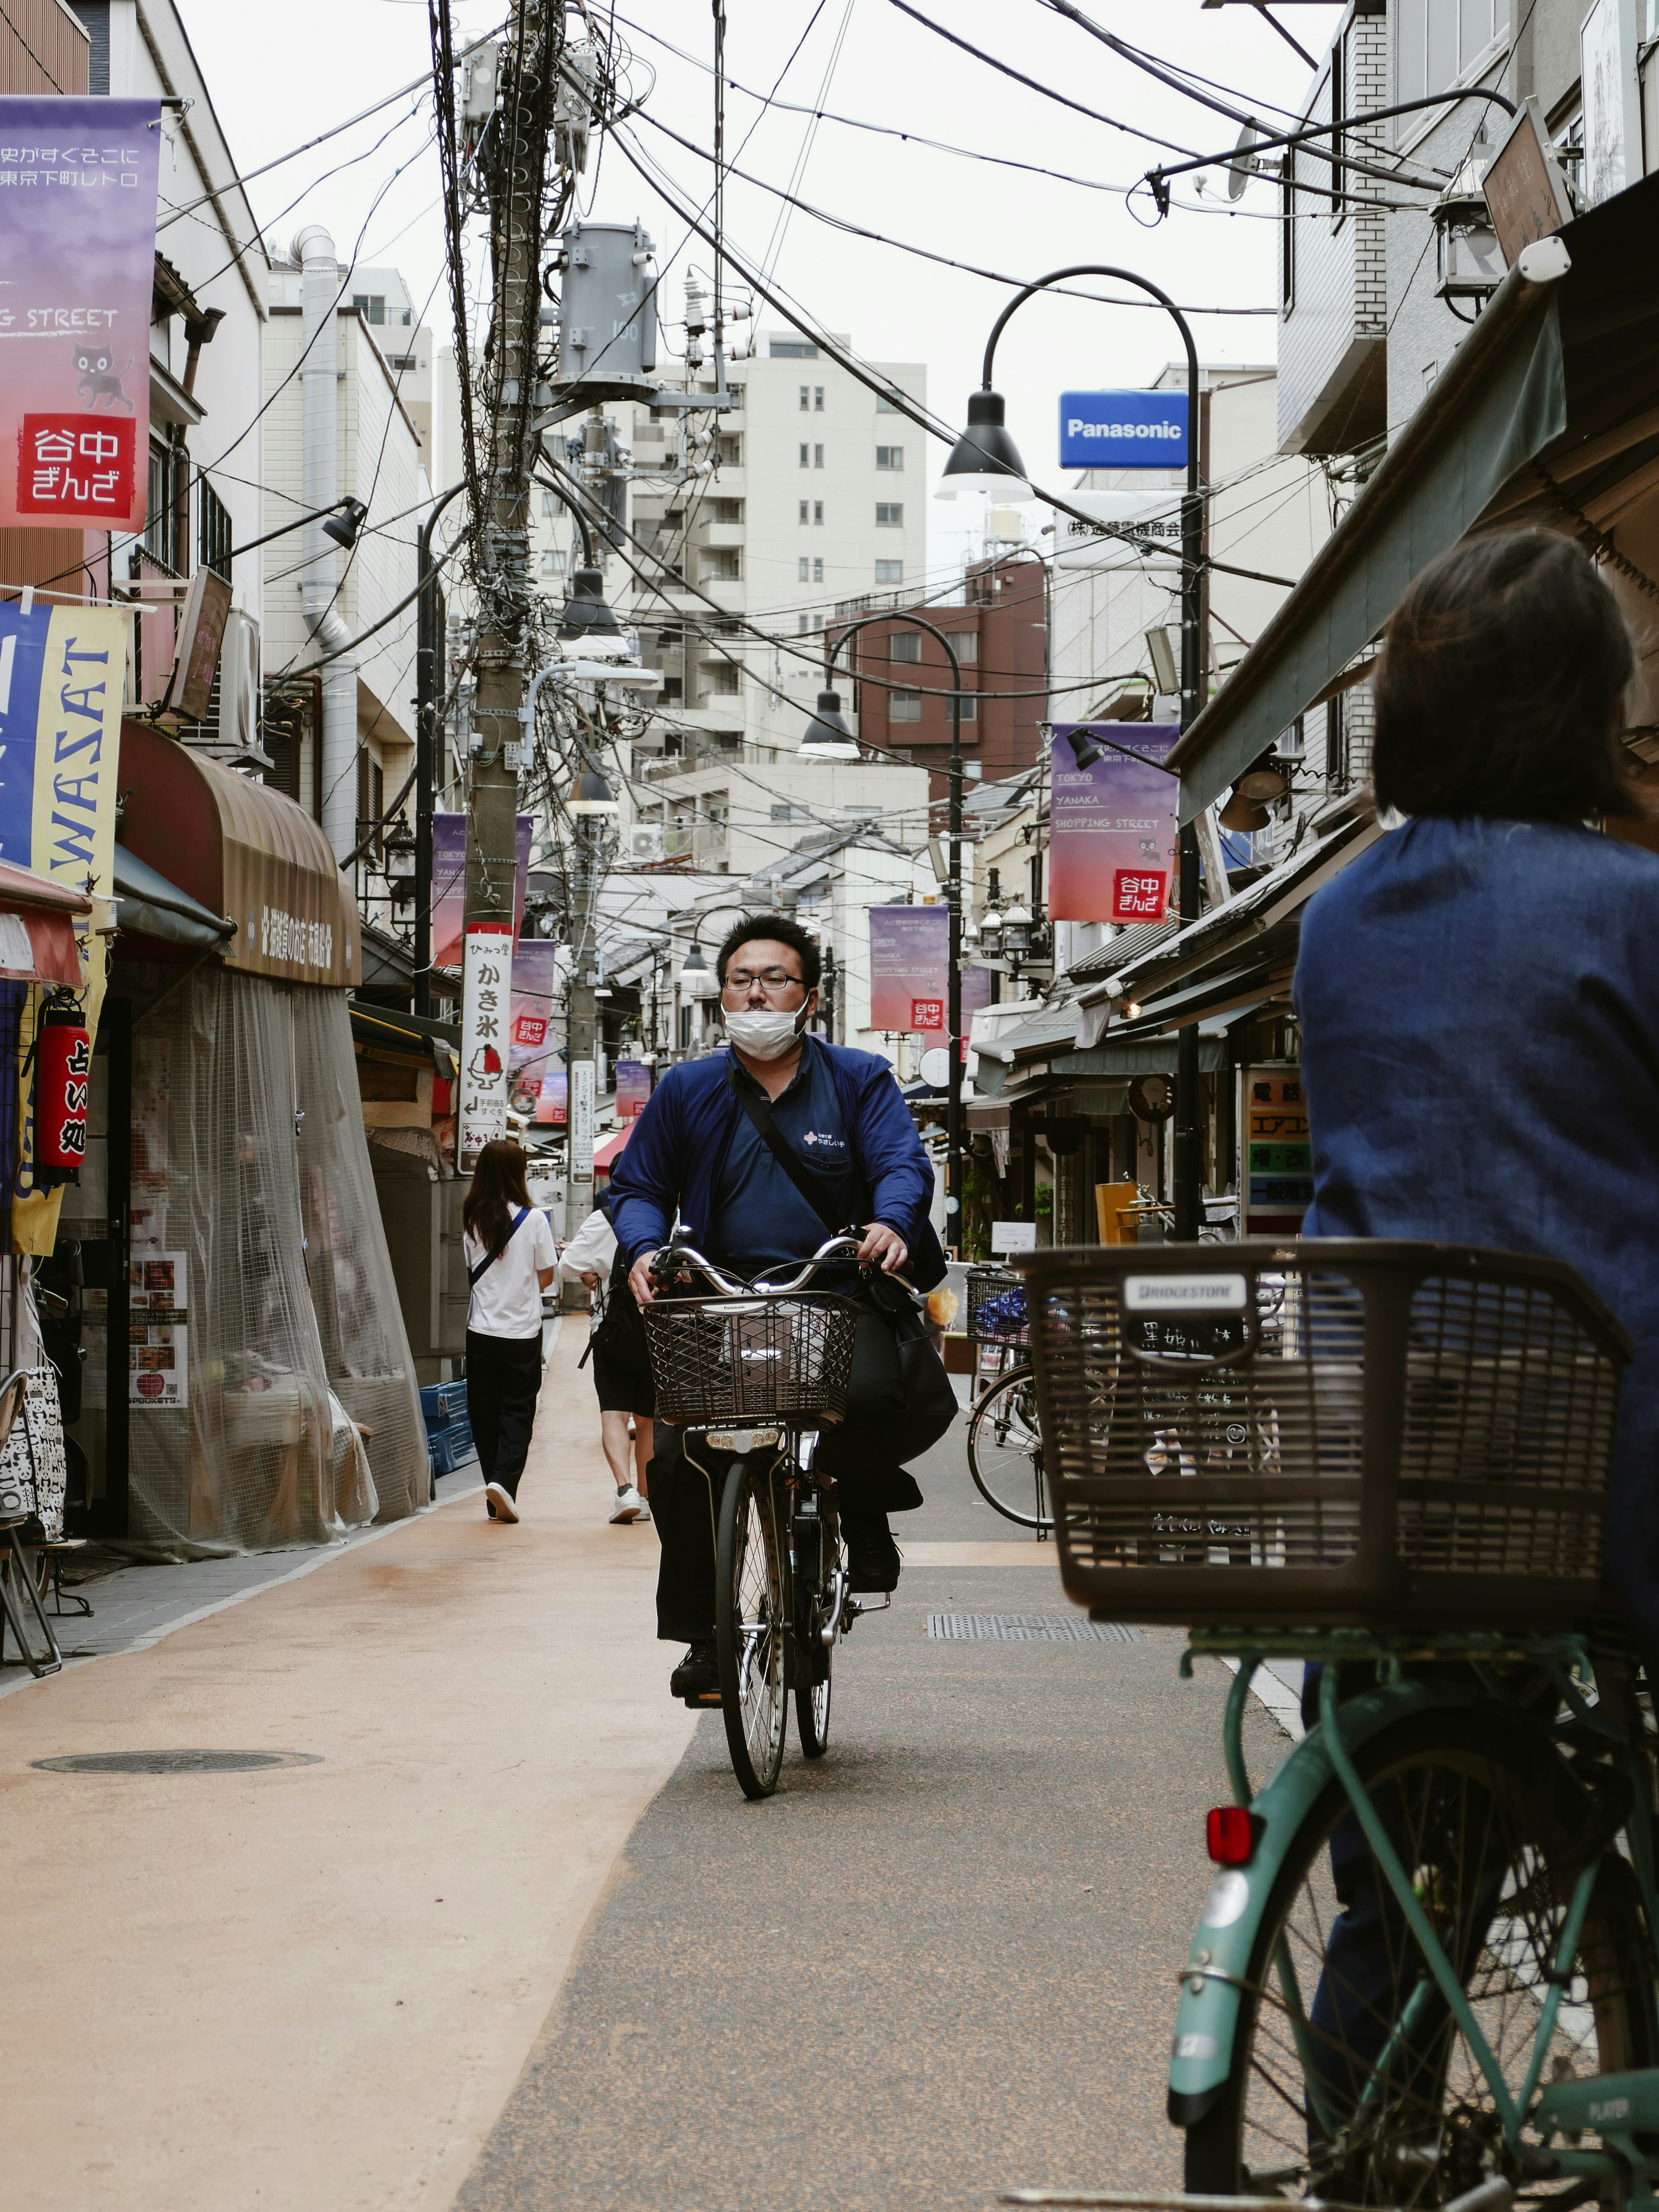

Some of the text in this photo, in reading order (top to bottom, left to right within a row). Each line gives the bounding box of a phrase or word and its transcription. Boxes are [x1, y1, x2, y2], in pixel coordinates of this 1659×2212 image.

[0, 147, 139, 164] 史がすぐそこに
[0, 170, 138, 187] 東京下町レトロ
[26, 307, 119, 327] STREET
[1067, 418, 1182, 439] Panasonic
[34, 429, 118, 463] 谷中
[31, 467, 120, 503] ぎんざ
[1056, 773, 1093, 783] TOKYO
[1056, 796, 1100, 805] YANAKA
[1055, 818, 1160, 829] SHOPPING STREET
[1121, 876, 1159, 894] 谷中
[1119, 895, 1159, 912] ぎんざ
[469, 942, 509, 955] ひみつ堂
[475, 963, 501, 1038] かき氷
[915, 1003, 940, 1014] 谷中
[521, 1020, 543, 1031] 谷中
[914, 1015, 940, 1026] ぎんざ
[60, 1040, 90, 1154] 占い処
[1253, 1082, 1300, 1101] 電話
[479, 1098, 504, 1107] 手前曲る
[480, 1108, 503, 1116] すぐ先
[818, 1138, 845, 1148] やさしい手
